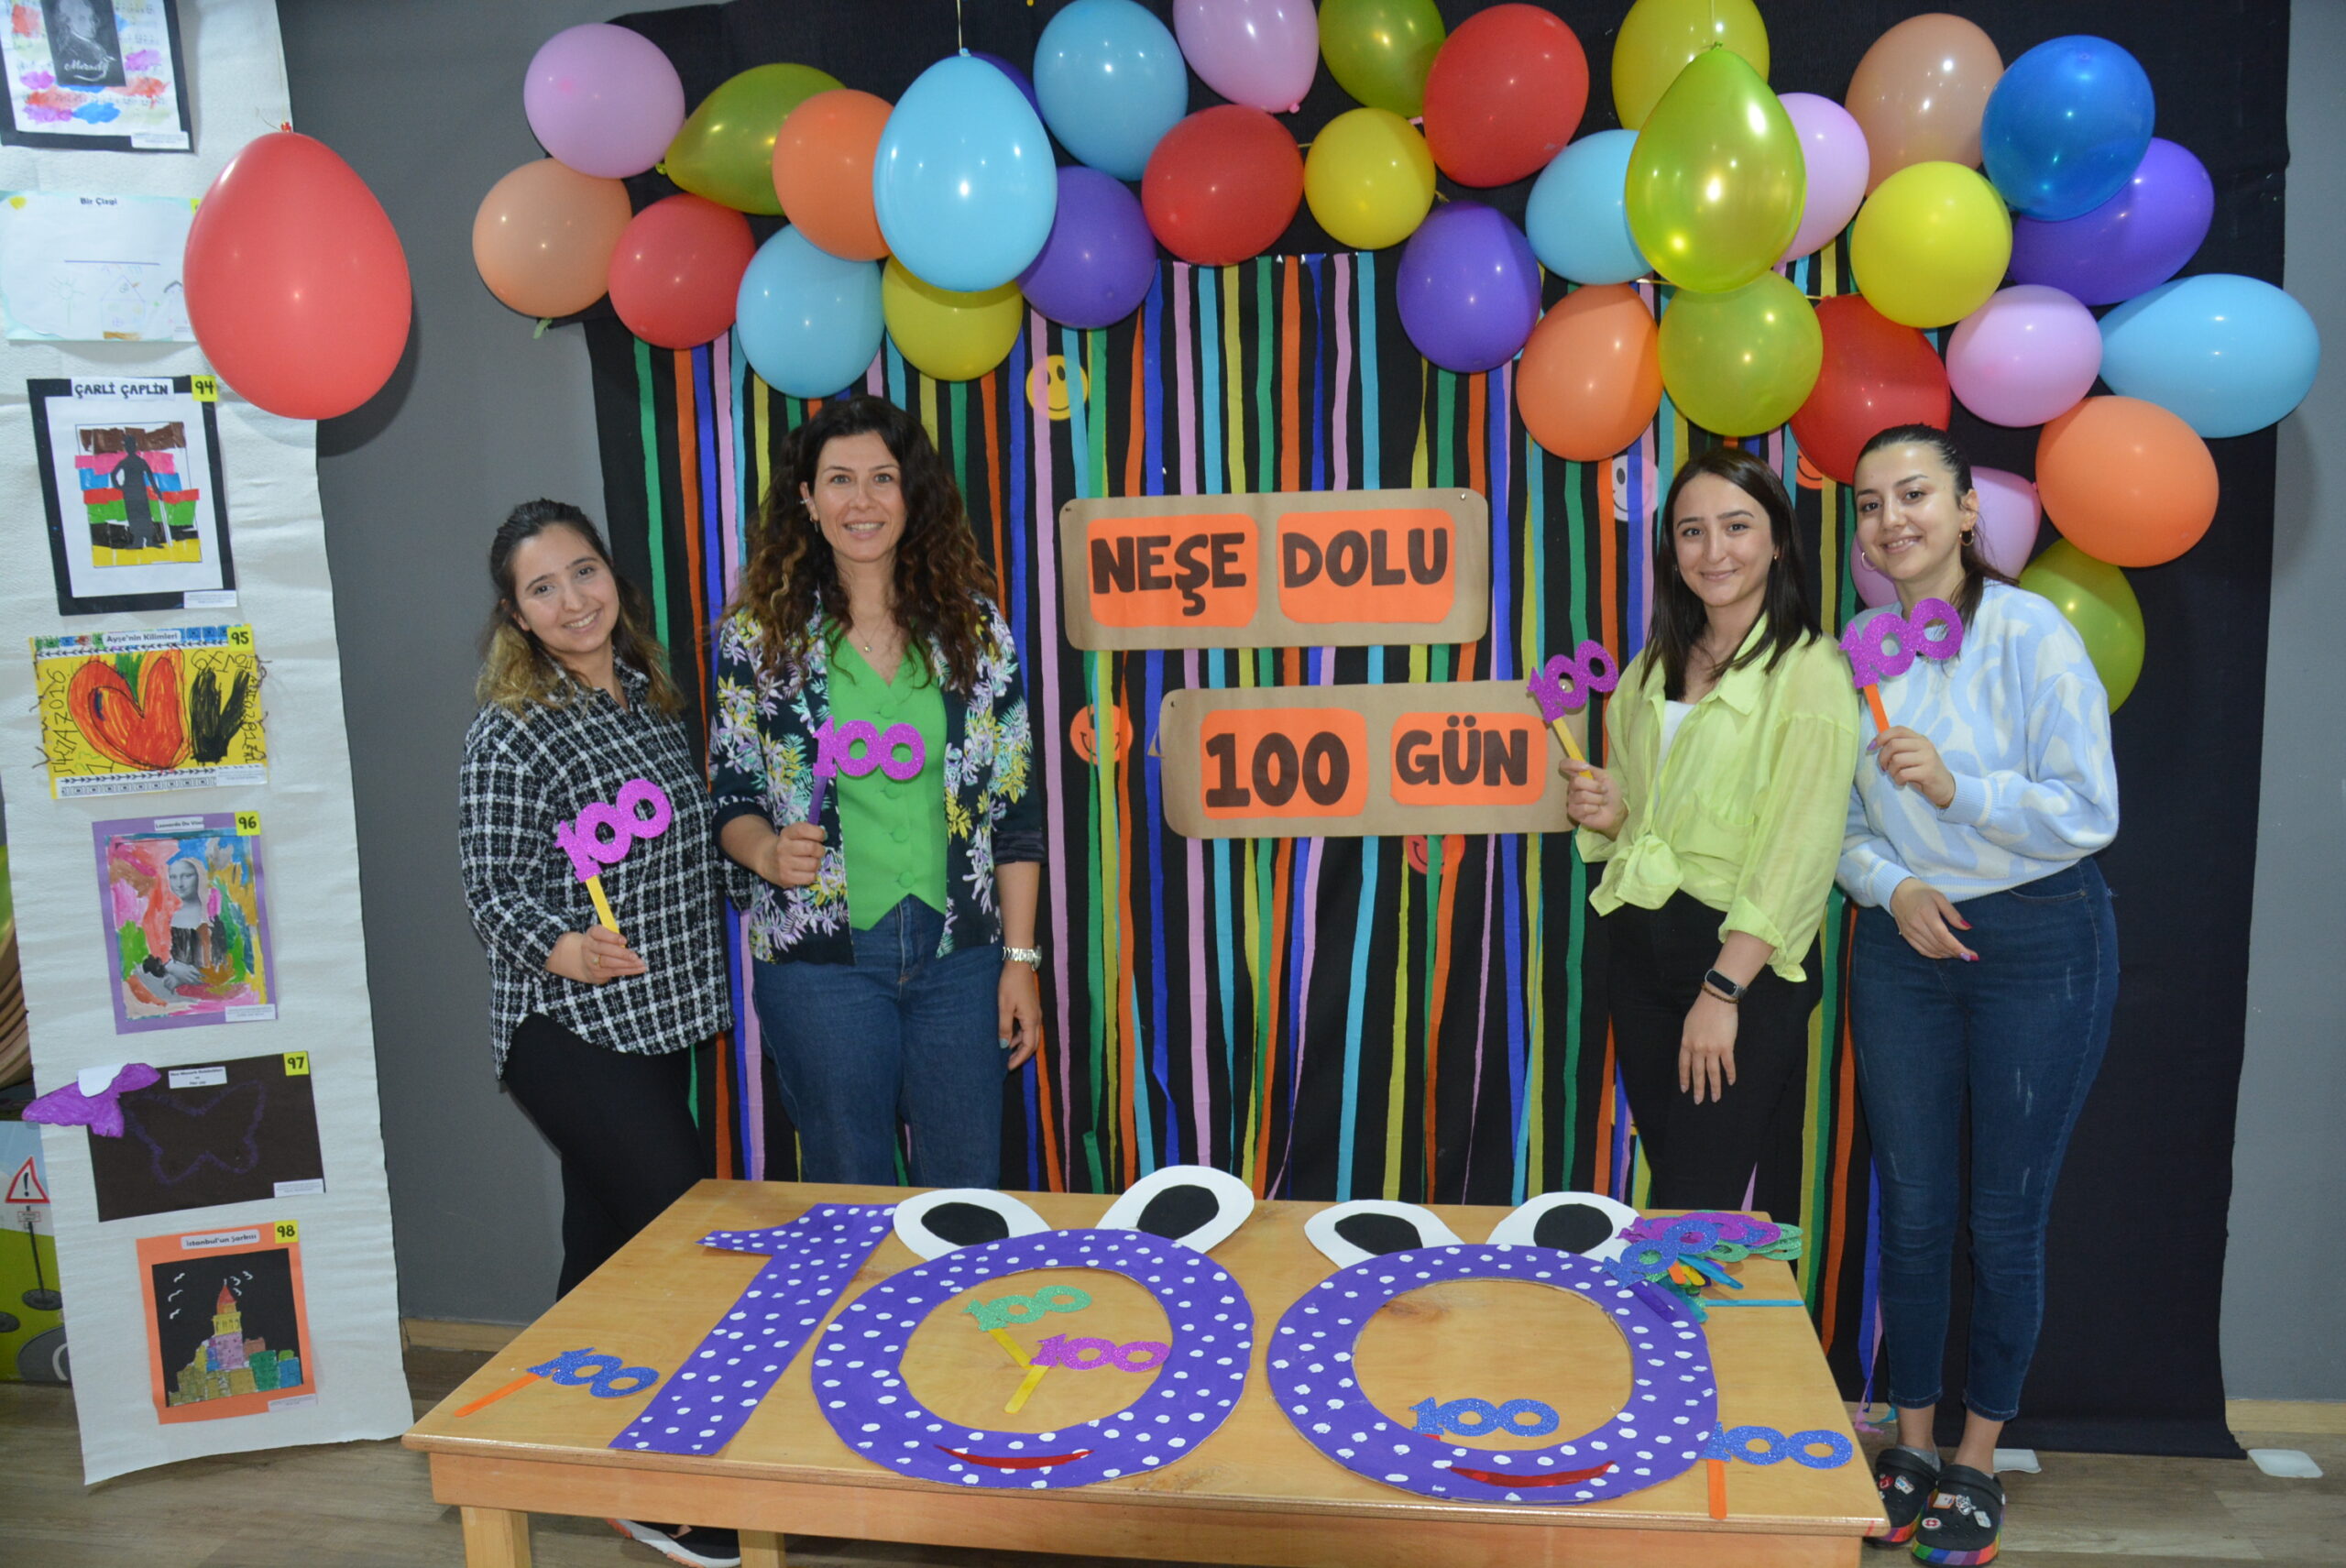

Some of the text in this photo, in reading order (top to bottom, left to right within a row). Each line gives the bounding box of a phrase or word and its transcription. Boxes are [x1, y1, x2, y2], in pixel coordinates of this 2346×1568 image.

[74, 381, 169, 399] ÇARLİ ÇAPLİN
[194, 380, 214, 395] 94
[1091, 527, 1448, 617] NEŞE DOLU
[106, 632, 178, 644] Ayşe'nin Kilimleri
[230, 630, 250, 646] 95
[1837, 597, 1964, 689] 100
[1527, 639, 1619, 723] 100
[812, 715, 926, 781] 100
[1204, 714, 1529, 809] 100 GÜN
[237, 815, 258, 830] 96
[554, 777, 673, 883] 100
[287, 1056, 305, 1070] 97
[277, 1224, 296, 1238] 98
[962, 1285, 1093, 1332] 100
[527, 1346, 660, 1398] 100
[1029, 1333, 1171, 1373] 100
[1409, 1396, 1561, 1438] 100
